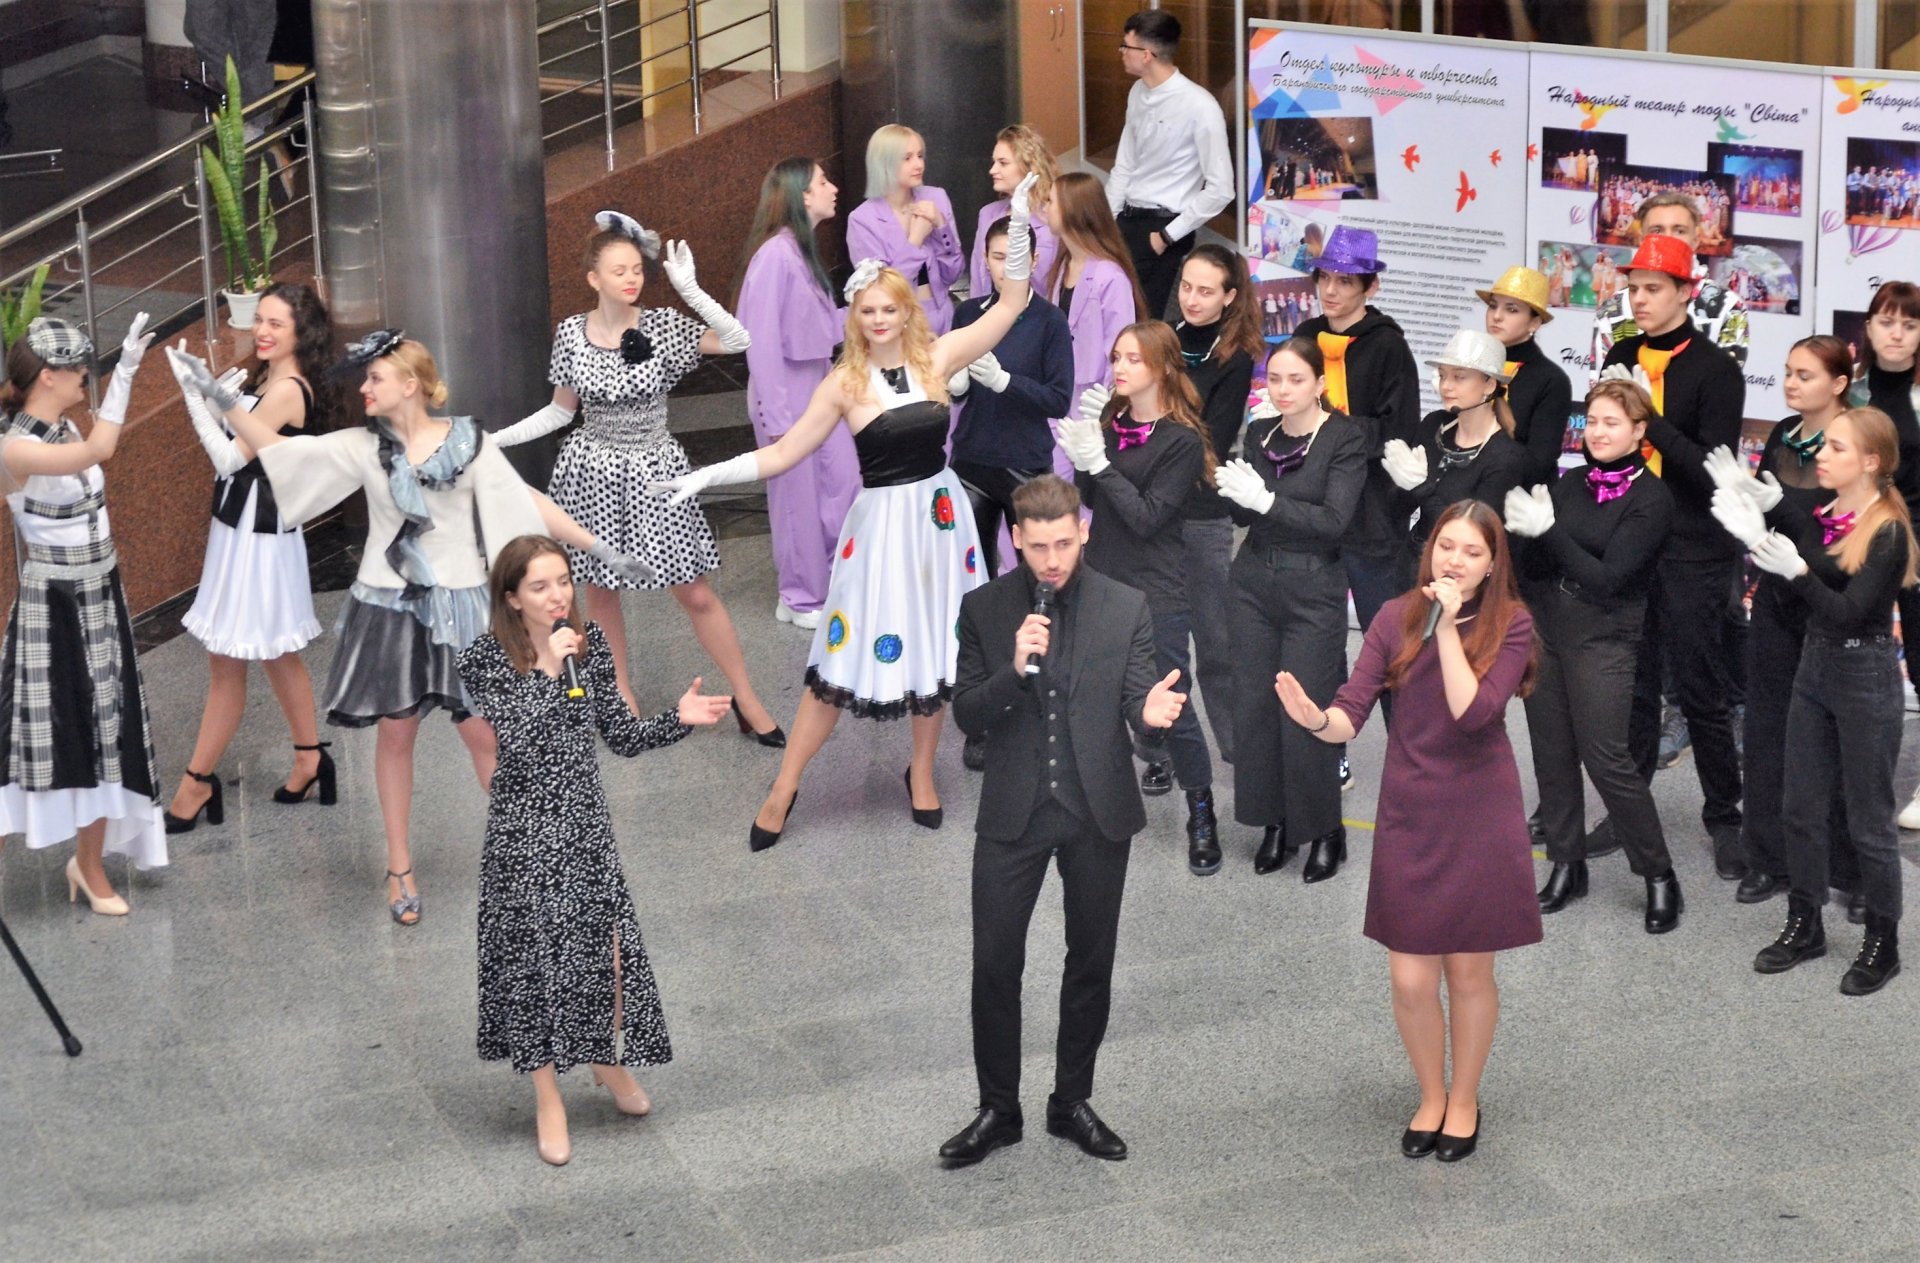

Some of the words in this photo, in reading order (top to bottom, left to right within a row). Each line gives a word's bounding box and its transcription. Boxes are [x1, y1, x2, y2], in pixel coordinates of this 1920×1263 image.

[1280, 50, 1325, 75] Отдел
[1329, 62, 1400, 79] культуры
[1406, 67, 1415, 79] и
[1419, 63, 1498, 86] творчества
[1351, 85, 1433, 99] государственного
[1436, 89, 1505, 106] университета
[1548, 85, 1631, 111] Народный
[1634, 101, 1686, 117] театр
[1692, 105, 1737, 122] моды
[1744, 102, 1808, 123] "Світа"
